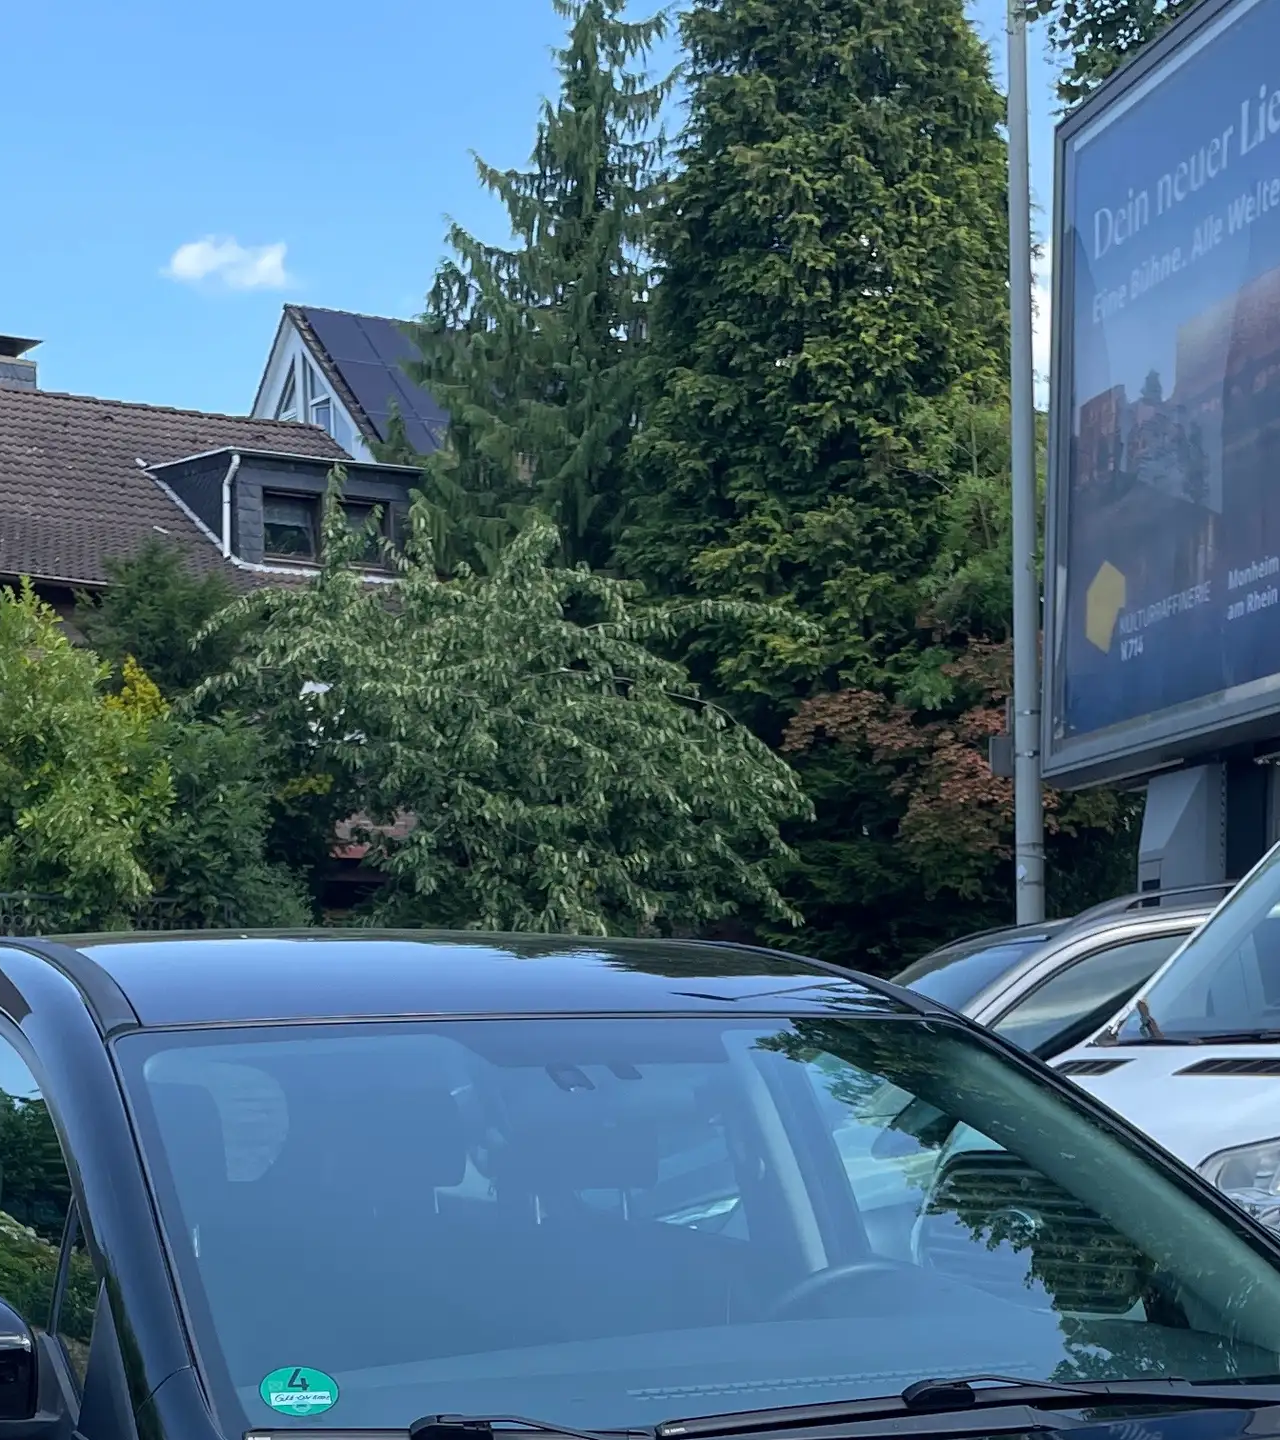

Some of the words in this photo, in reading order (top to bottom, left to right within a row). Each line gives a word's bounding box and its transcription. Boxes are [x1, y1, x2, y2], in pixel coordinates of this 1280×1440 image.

[1094, 188, 1148, 260] Dein
[1157, 125, 1233, 216] neuer
[1092, 284, 1126, 324] Eine
[1131, 247, 1187, 300] Bühne.
[1191, 214, 1222, 261] Alle
[1228, 555, 1279, 590] Monheim
[1227, 603, 1244, 621] am
[1247, 585, 1278, 613] Rhein
[287, 1368, 310, 1391] 4
